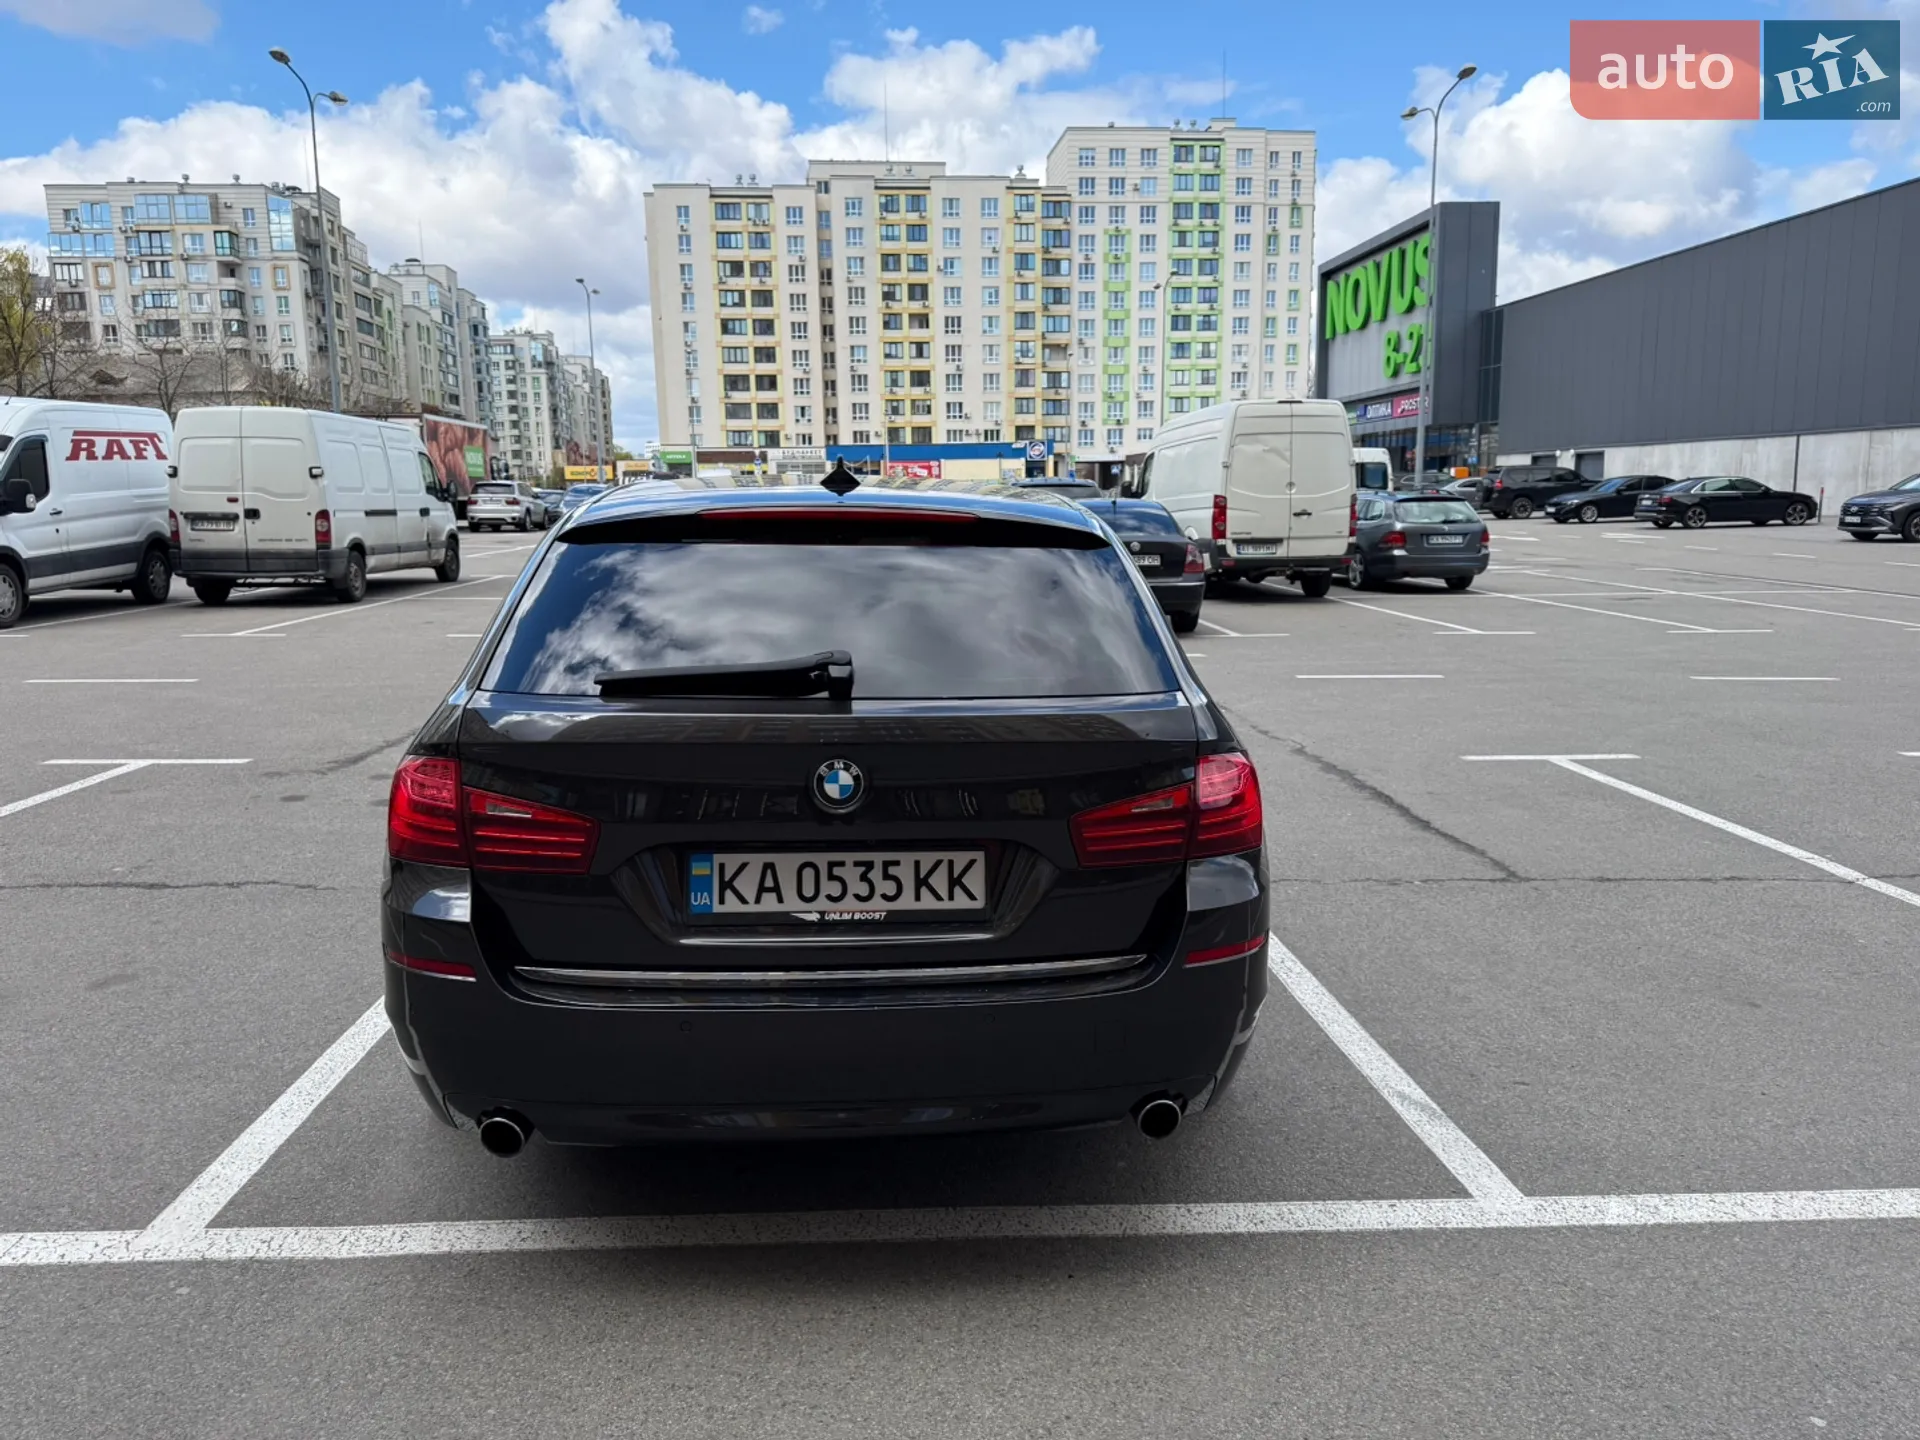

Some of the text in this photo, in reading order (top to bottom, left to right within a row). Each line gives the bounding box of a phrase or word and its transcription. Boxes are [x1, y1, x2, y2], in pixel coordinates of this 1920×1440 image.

[1325, 233, 1432, 339] NOVUS
[65, 430, 168, 461] RAFT
[819, 761, 859, 777] BMW
[718, 858, 979, 906] KA 0535 KK
[691, 892, 711, 906] UA
[824, 911, 887, 921] UNLIM BOOST
